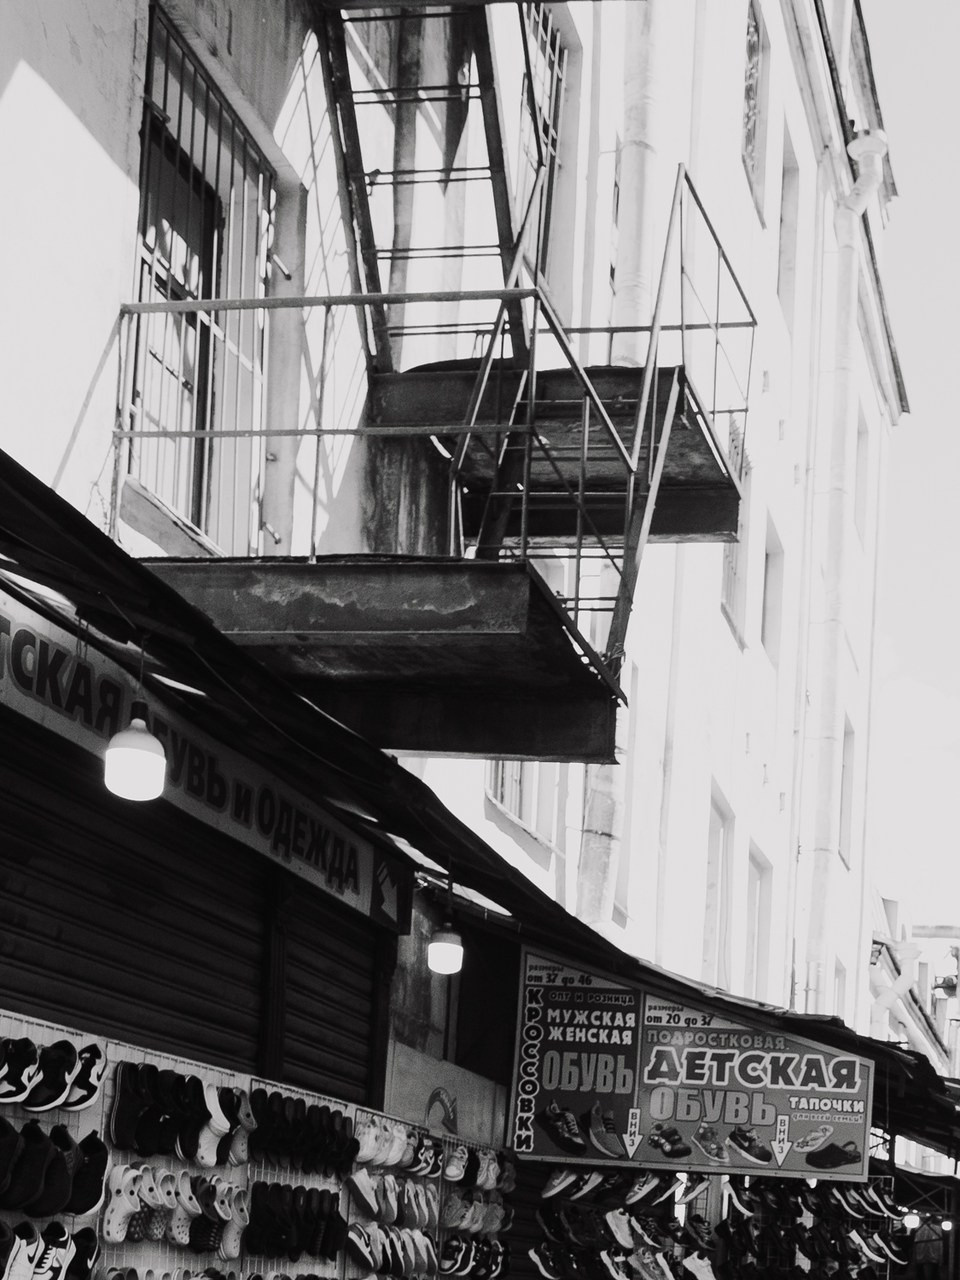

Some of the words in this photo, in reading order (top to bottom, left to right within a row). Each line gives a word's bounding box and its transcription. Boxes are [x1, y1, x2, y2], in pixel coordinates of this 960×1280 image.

[257, 785, 360, 895] ОДЕЖДА
[545, 973, 559, 984] 37
[577, 975, 593, 986] 46
[549, 991, 571, 1002] ОПТ
[574, 992, 585, 1003] И
[587, 992, 635, 1006] РОЗНИЦА
[647, 1004, 685, 1013] размеры
[546, 1008, 636, 1028] МУЖСКАЯ
[665, 1013, 681, 1025] 20
[700, 1014, 714, 1026] 37
[547, 1025, 633, 1046] ЖЕНСКАЯ
[514, 986, 545, 1152] КРОССОВКИ
[541, 1049, 635, 1095] ОБУВЬ
[644, 1046, 861, 1093] ДЕТСКАЯ
[649, 1086, 777, 1127] ОБУВЬ
[789, 1096, 865, 1113] ТАПОЧКИ
[628, 1112, 638, 1147] ВНИЗ
[777, 1118, 786, 1154] ВНИЗ
